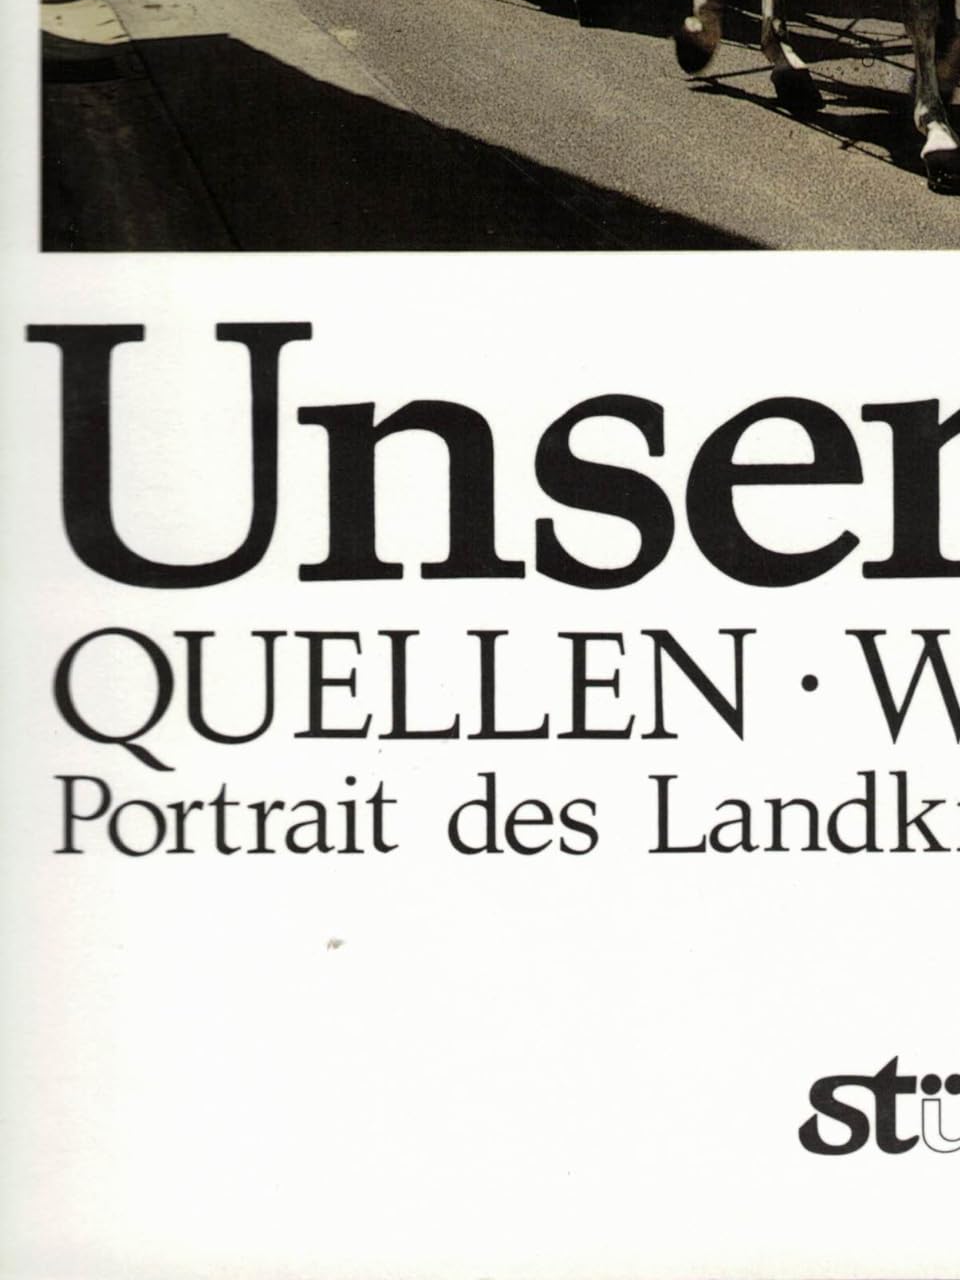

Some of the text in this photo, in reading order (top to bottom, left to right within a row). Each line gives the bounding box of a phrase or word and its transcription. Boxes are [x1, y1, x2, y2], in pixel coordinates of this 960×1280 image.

[53, 627, 757, 772] QUELLEN
[54, 775, 399, 858] Portrait
[447, 771, 599, 856] des
